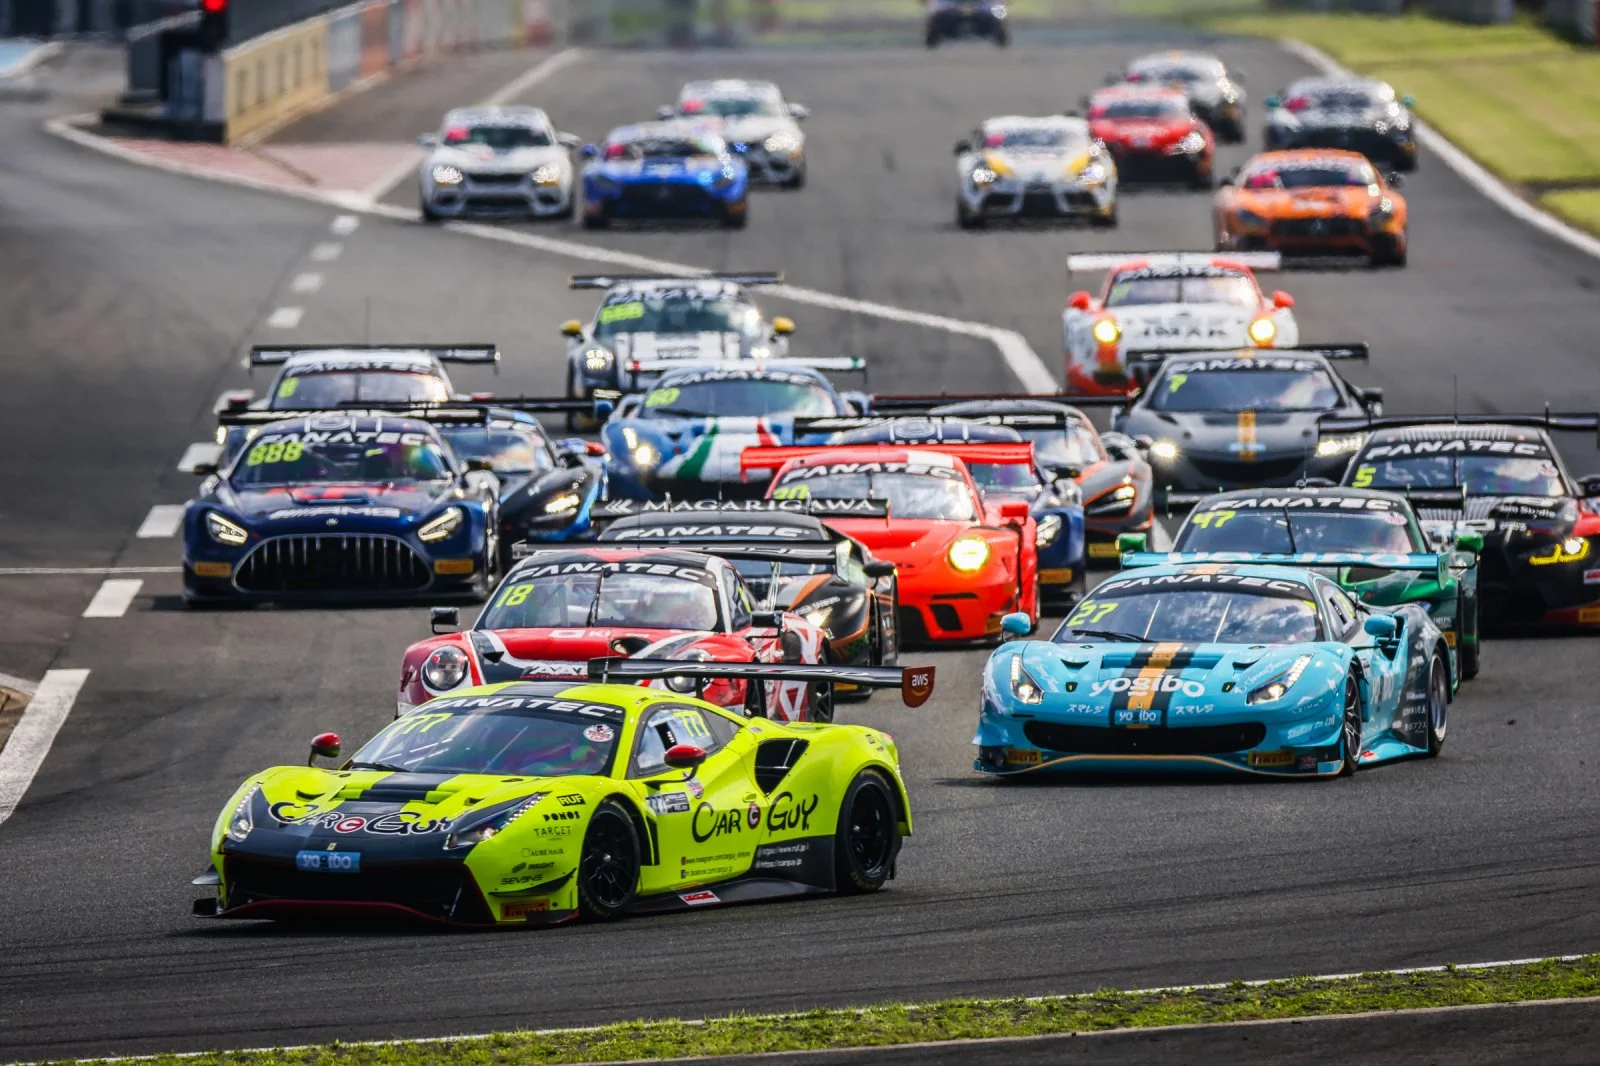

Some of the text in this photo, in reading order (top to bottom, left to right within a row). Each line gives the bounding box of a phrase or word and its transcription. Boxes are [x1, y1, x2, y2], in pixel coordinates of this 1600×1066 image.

[1166, 358, 1320, 374] FANATEC
[1169, 374, 1189, 394] 7
[254, 431, 426, 448] FANATEC
[247, 442, 305, 467] 888
[1364, 440, 1540, 461] FANATEC
[782, 463, 959, 486] FANATEC
[1351, 466, 1377, 488] 5
[641, 499, 879, 513] MAGARIGAWA
[1210, 497, 1390, 511] FANATEC
[1191, 511, 1237, 529] 47
[615, 525, 805, 541] FANATEC
[509, 562, 706, 584] FANATEC
[1099, 574, 1299, 594] FANATEC
[495, 584, 535, 609] 18
[1066, 599, 1119, 627] 27
[911, 673, 930, 688] aws
[1088, 674, 1206, 697] yogibo
[414, 698, 617, 717] FANATEC
[1175, 703, 1215, 715] スマレジ
[1119, 711, 1157, 723] yoibo
[558, 794, 584, 805] RUF
[364, 811, 454, 835] GUY
[543, 811, 581, 822] PONOS
[692, 801, 741, 843] CAR
[767, 791, 819, 837] GUY
[533, 825, 572, 837] TARGET
[302, 853, 351, 869] yoibo
